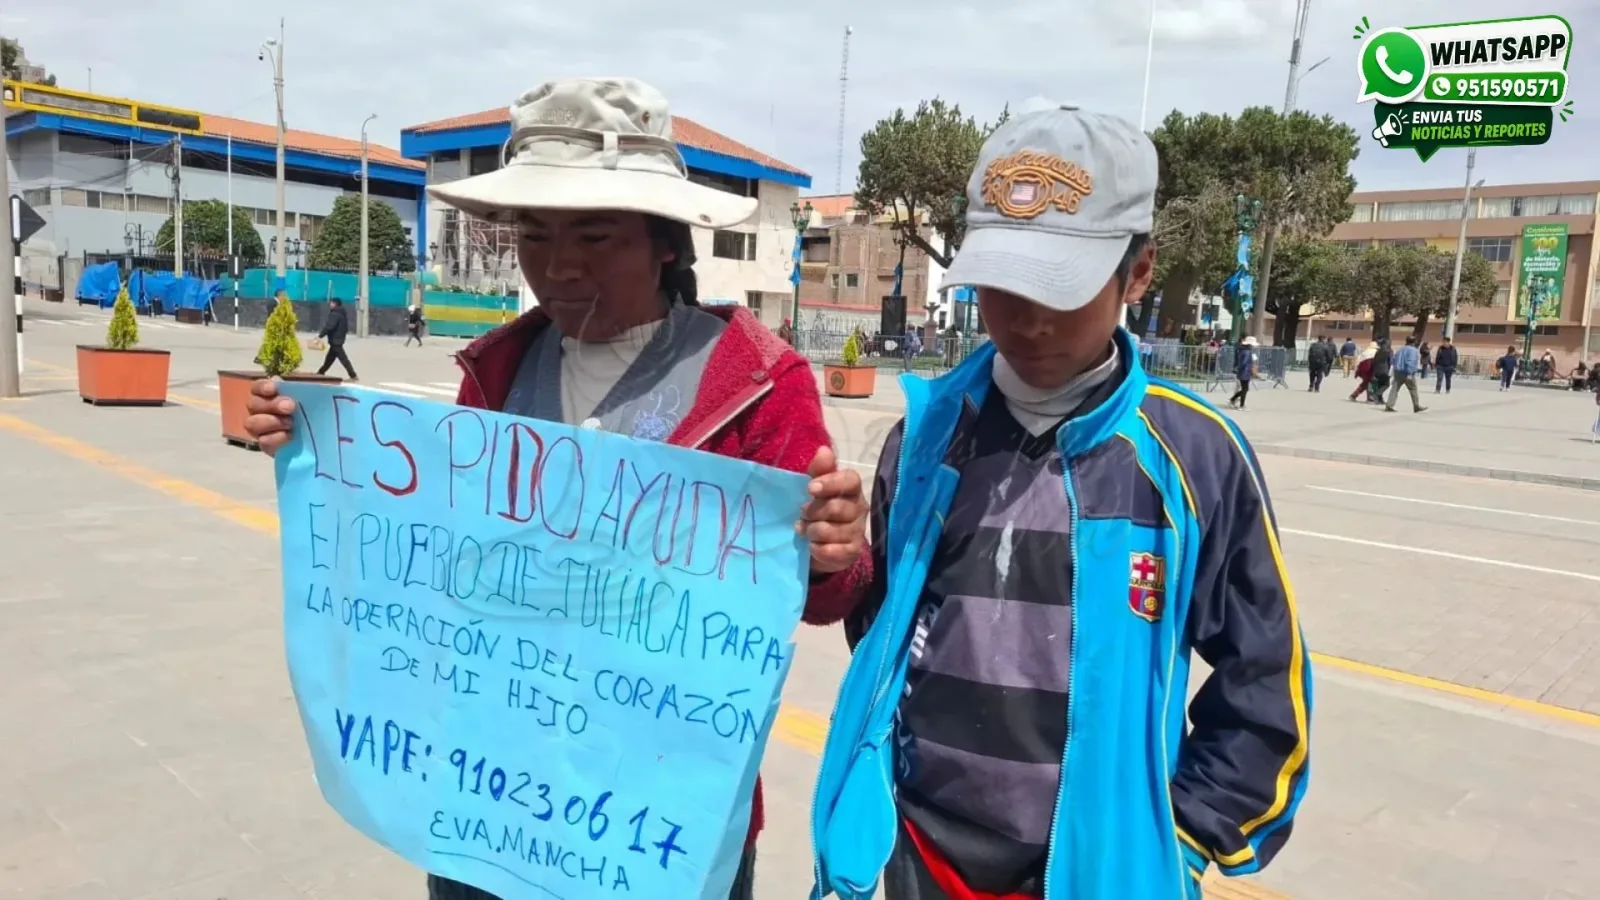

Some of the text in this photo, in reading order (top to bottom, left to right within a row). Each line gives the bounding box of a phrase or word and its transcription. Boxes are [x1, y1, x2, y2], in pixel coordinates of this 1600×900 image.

[298, 395, 419, 497] LES
[435, 409, 585, 540] PIDO
[589, 457, 757, 585] AYUDA
[307, 583, 760, 744] LA OPERACIÓN DEL CORAZÓN
[351, 513, 483, 600] PUEBLO
[485, 541, 542, 612] DE
[702, 611, 785, 675] PARA
[333, 708, 433, 782] YAPE:
[380, 646, 589, 734] DE MI HIJO
